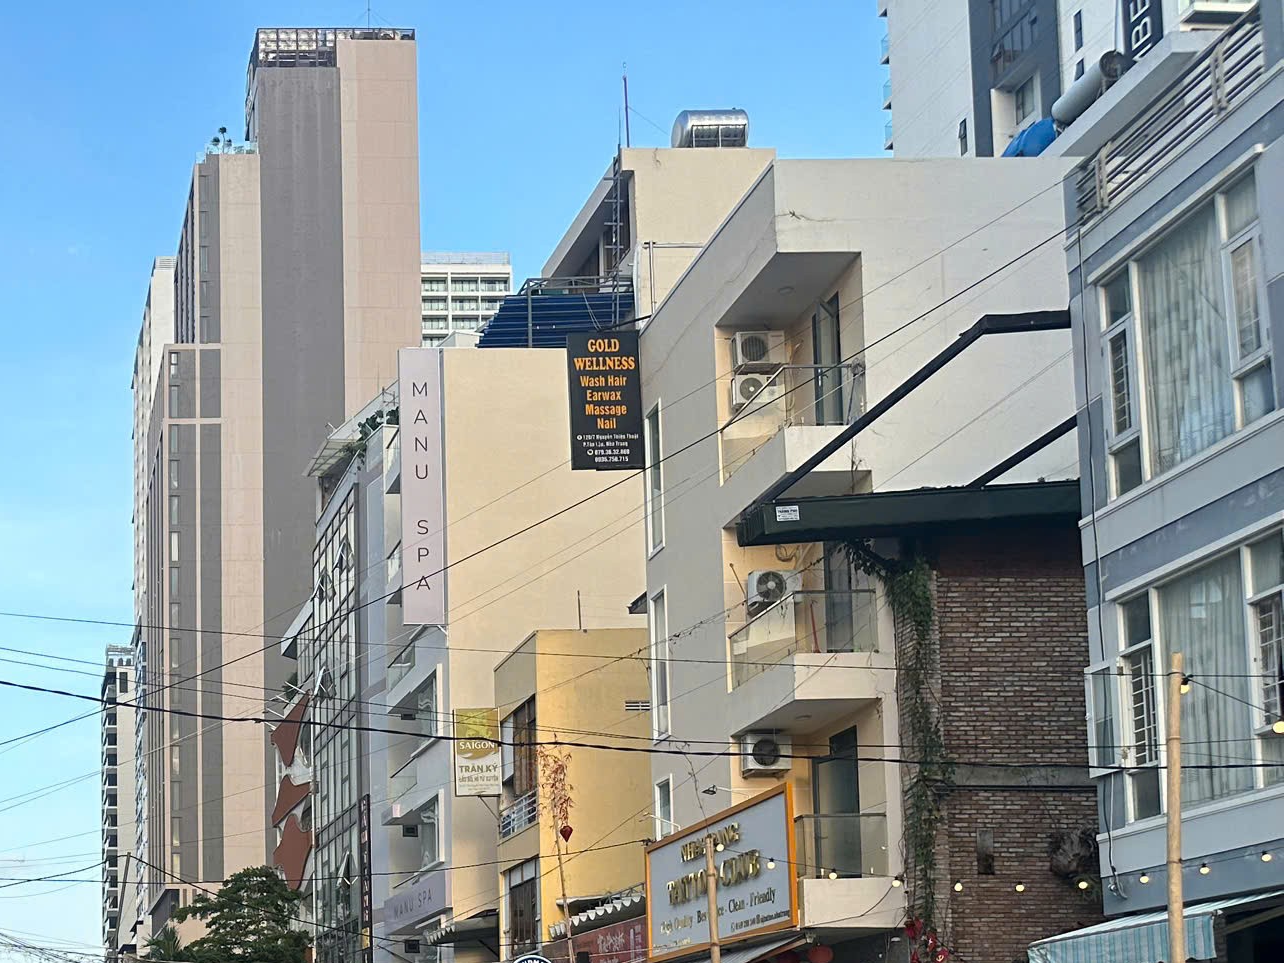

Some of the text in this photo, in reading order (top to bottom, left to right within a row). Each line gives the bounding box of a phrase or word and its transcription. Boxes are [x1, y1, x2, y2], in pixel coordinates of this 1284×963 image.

[587, 338, 620, 353] GOLD
[573, 356, 635, 371] WELLNESS
[580, 375, 627, 387] Wash Hair
[586, 389, 621, 401] Earwax
[585, 404, 627, 416] Massage
[597, 417, 616, 430] Nail
[412, 382, 431, 591] MANU SPA
[459, 741, 495, 750] SAIGON
[667, 867, 718, 906] TATTO
[418, 888, 433, 909] SPA
[728, 899, 745, 913] Clean
[750, 887, 776, 907] Friendly
